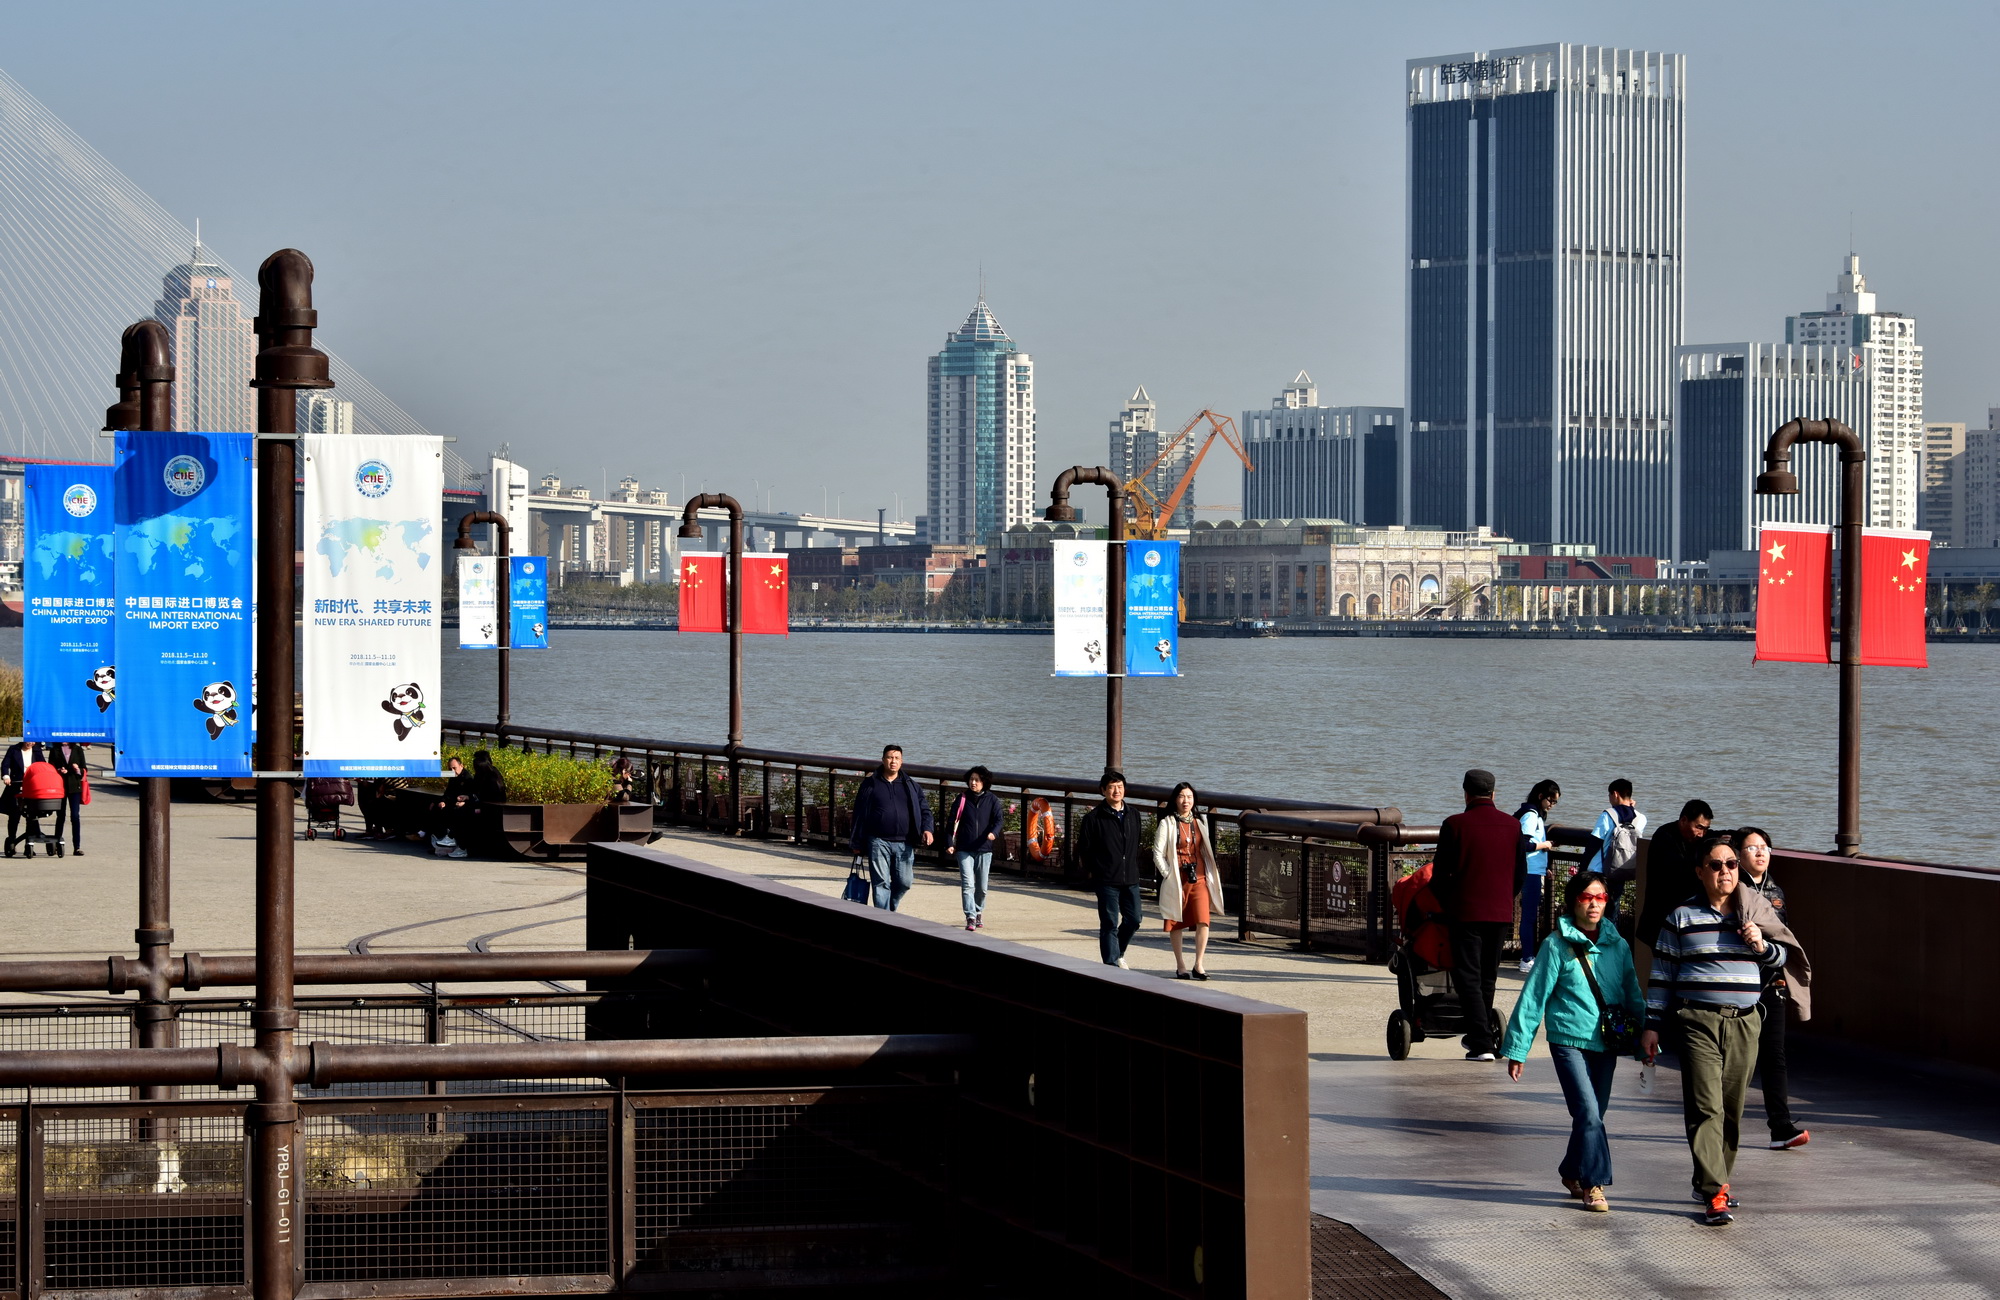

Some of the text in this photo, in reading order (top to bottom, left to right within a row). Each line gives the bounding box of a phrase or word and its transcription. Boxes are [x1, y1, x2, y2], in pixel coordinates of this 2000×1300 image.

[1440, 56, 1522, 85] 陆家嘴地产
[31, 597, 115, 608] 中国国际进口博览
[125, 596, 243, 609] 中国国际进口博览会
[314, 598, 432, 614] 新时代、共享未来
[60, 609, 115, 617] INTERNATION
[125, 611, 159, 619] CHINA
[161, 611, 243, 620] INTERNATIONAL
[85, 617, 108, 625] EXPO
[149, 621, 220, 630] IMPORT EXPO
[314, 618, 432, 627] NEW ERA SHARED FUTURE
[1280, 860, 1293, 877] 友善
[277, 1144, 290, 1243] YPBJ-G1-011
